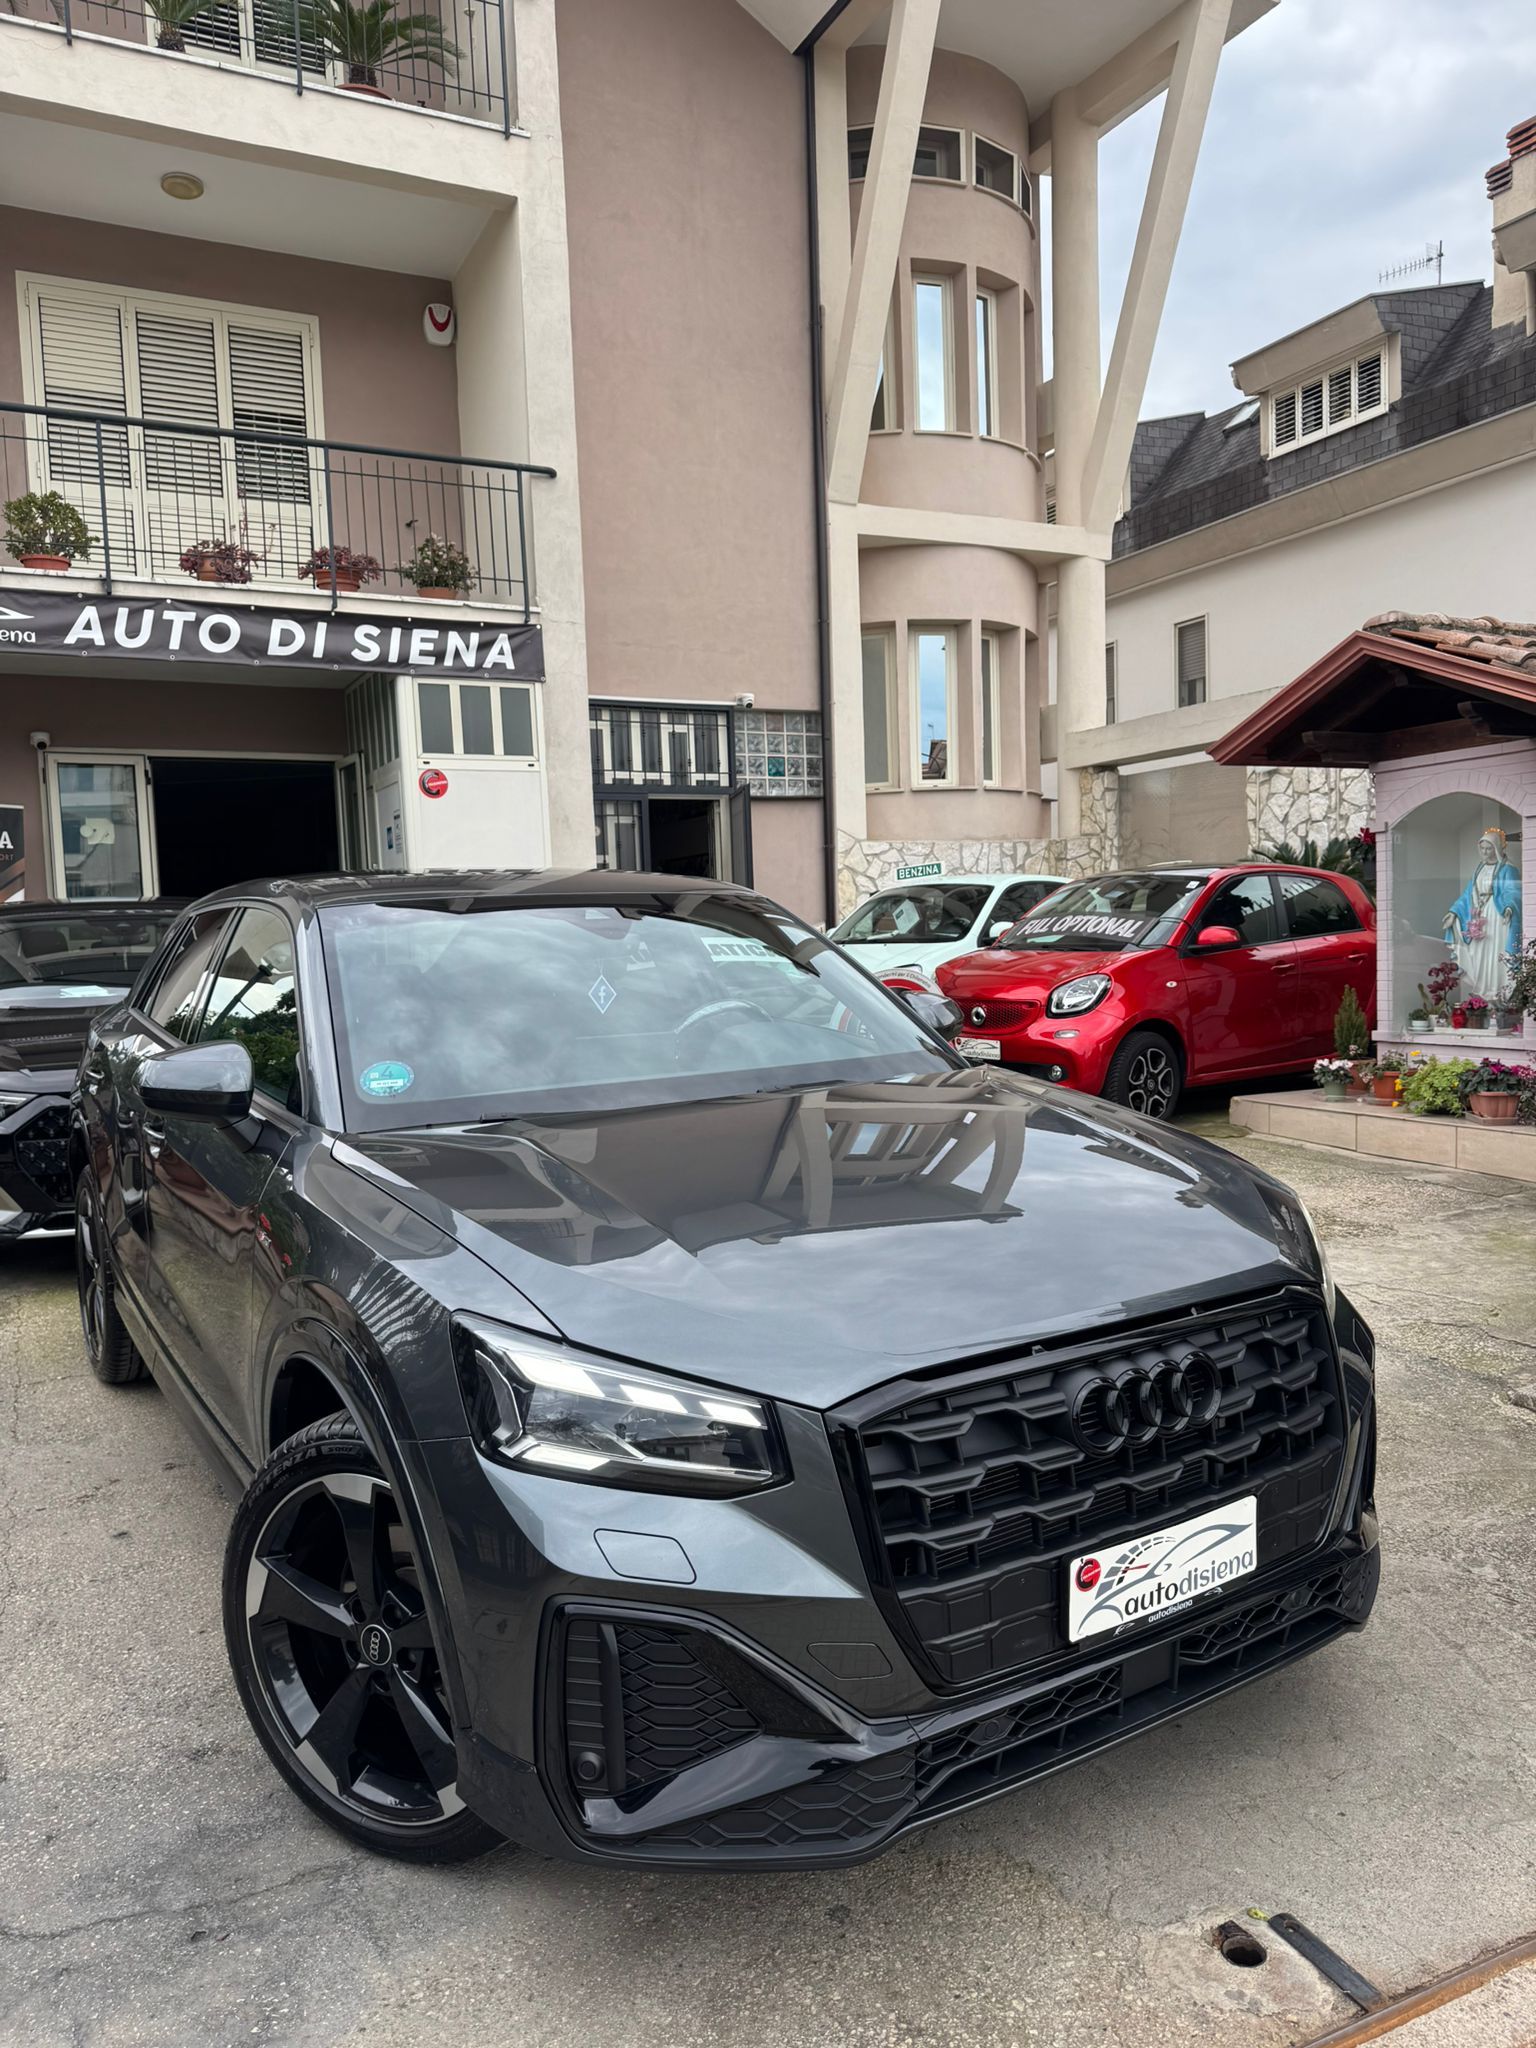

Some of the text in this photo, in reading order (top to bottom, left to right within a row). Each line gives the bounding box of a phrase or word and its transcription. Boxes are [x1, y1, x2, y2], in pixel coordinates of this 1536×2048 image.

[64, 606, 515, 670] AUTO DI SIENA
[899, 865, 940, 879] BENZINA
[1016, 915, 1144, 938] FULL OPTIONAL
[707, 943, 776, 957] ATIC
[381, 1065, 394, 1079] 4
[1124, 1549, 1254, 1616] autodisiena
[1148, 1599, 1193, 1623] autodisiena
